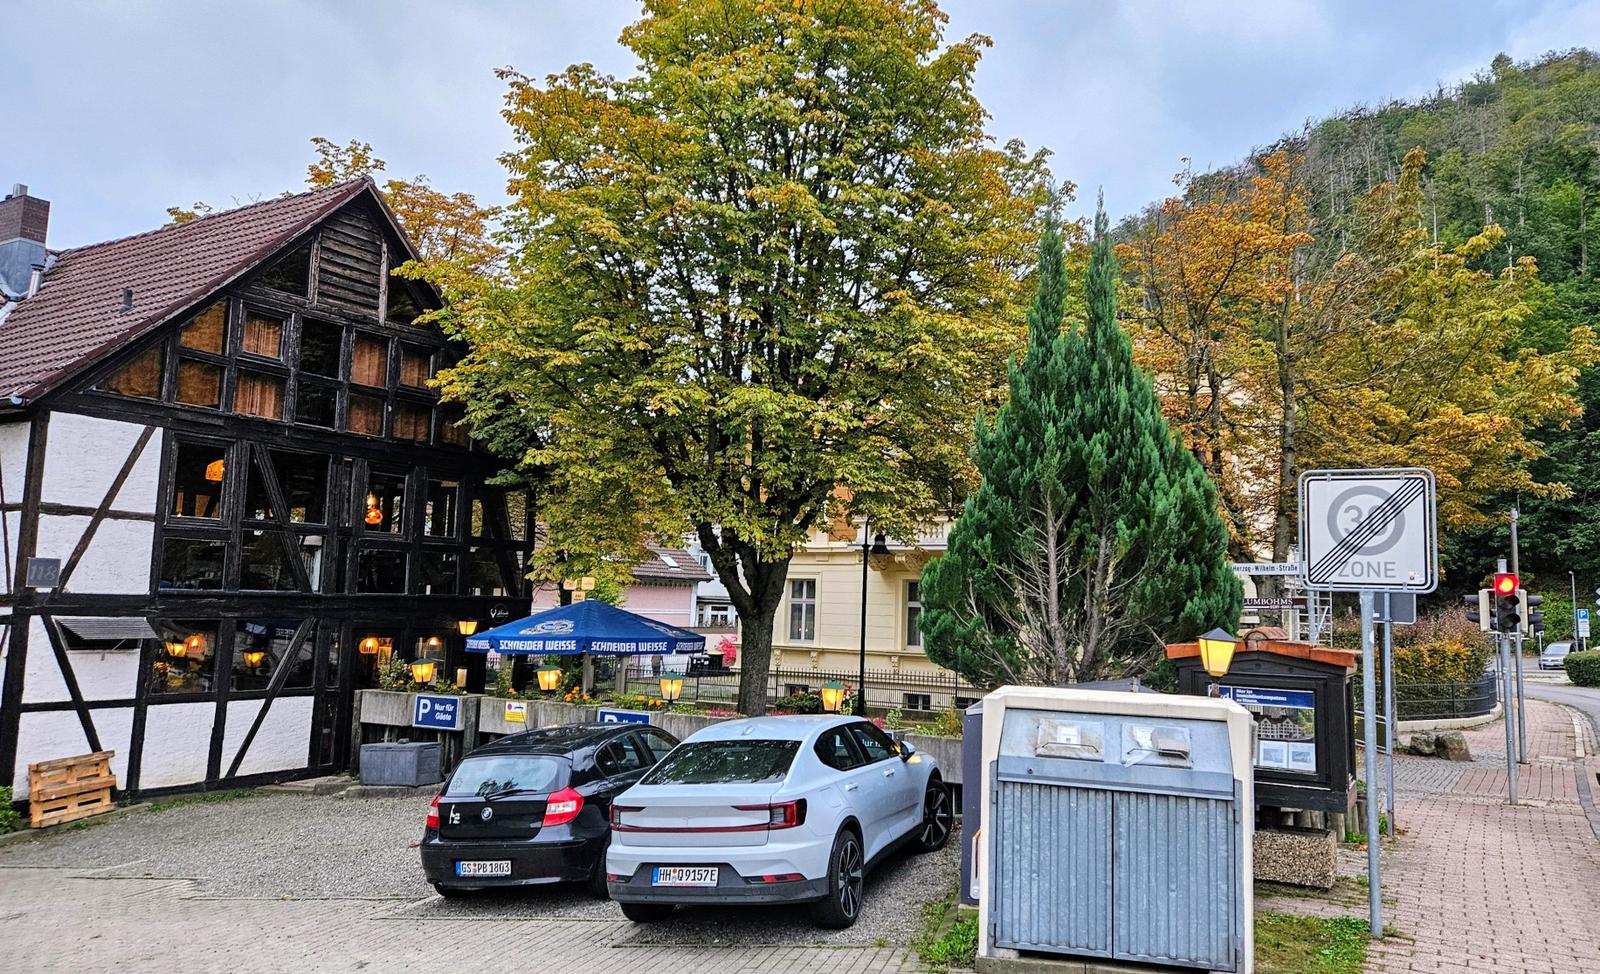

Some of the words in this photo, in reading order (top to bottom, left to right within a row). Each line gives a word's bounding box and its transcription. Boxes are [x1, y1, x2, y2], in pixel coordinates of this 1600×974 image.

[1338, 561, 1397, 578] ZONE
[499, 640, 543, 651] SCHNEIDER
[545, 640, 577, 651] WEISSE
[590, 641, 637, 652] SCHNEIDER
[638, 641, 668, 652] WEISSE
[418, 699, 432, 722] P
[435, 703, 445, 711] Nur
[445, 703, 455, 712] für
[435, 711, 452, 721] Gäste
[461, 862, 472, 874] GS
[477, 862, 488, 873] PB
[489, 862, 510, 873] 1803
[659, 868, 671, 881] HH
[677, 868, 684, 882] Q
[685, 868, 717, 882] 9157E
